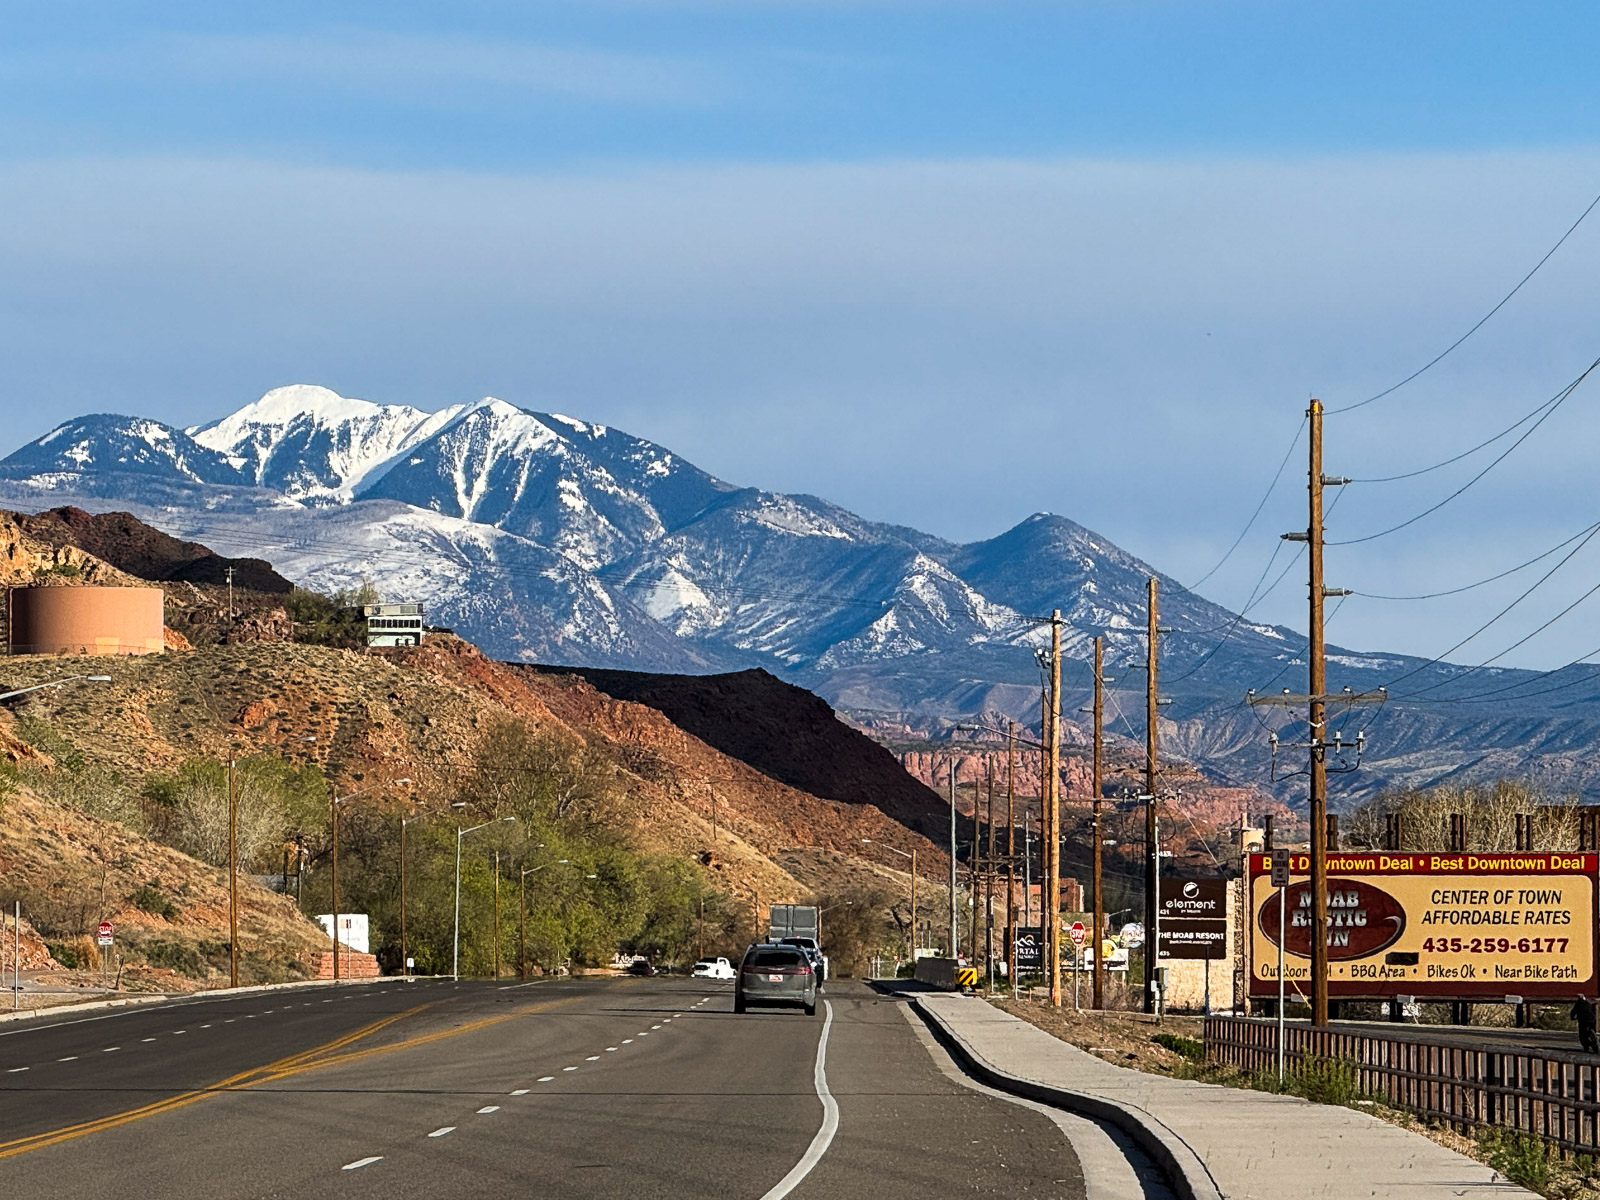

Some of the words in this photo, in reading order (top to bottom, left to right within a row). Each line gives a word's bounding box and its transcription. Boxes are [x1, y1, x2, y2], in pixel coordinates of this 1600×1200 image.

[1262, 856, 1295, 870] Bt
[1299, 856, 1375, 870] Dntown
[1379, 857, 1413, 870] Deal
[1431, 857, 1464, 870] Best
[1468, 857, 1546, 870] Downtown
[1551, 856, 1585, 870] Deal
[1165, 898, 1216, 909] element
[1431, 889, 1489, 905] CENTER
[1493, 889, 1514, 905] OF
[1518, 889, 1562, 905] TOWN
[1291, 909, 1368, 927] RSTIC
[1421, 910, 1520, 925] AFFORDABLE
[1524, 910, 1571, 925] RATES
[1071, 929, 1085, 938] STOP
[1195, 932, 1225, 940] RESORT
[1422, 938, 1569, 953] 435-259-6177
[1351, 965, 1378, 978] BBQ
[1379, 965, 1406, 978] Area
[1427, 964, 1459, 978] Bikes
[1460, 964, 1476, 978] Ok
[1495, 964, 1522, 978] Near
[1524, 964, 1549, 978] Bike
[1551, 964, 1578, 978] Path
